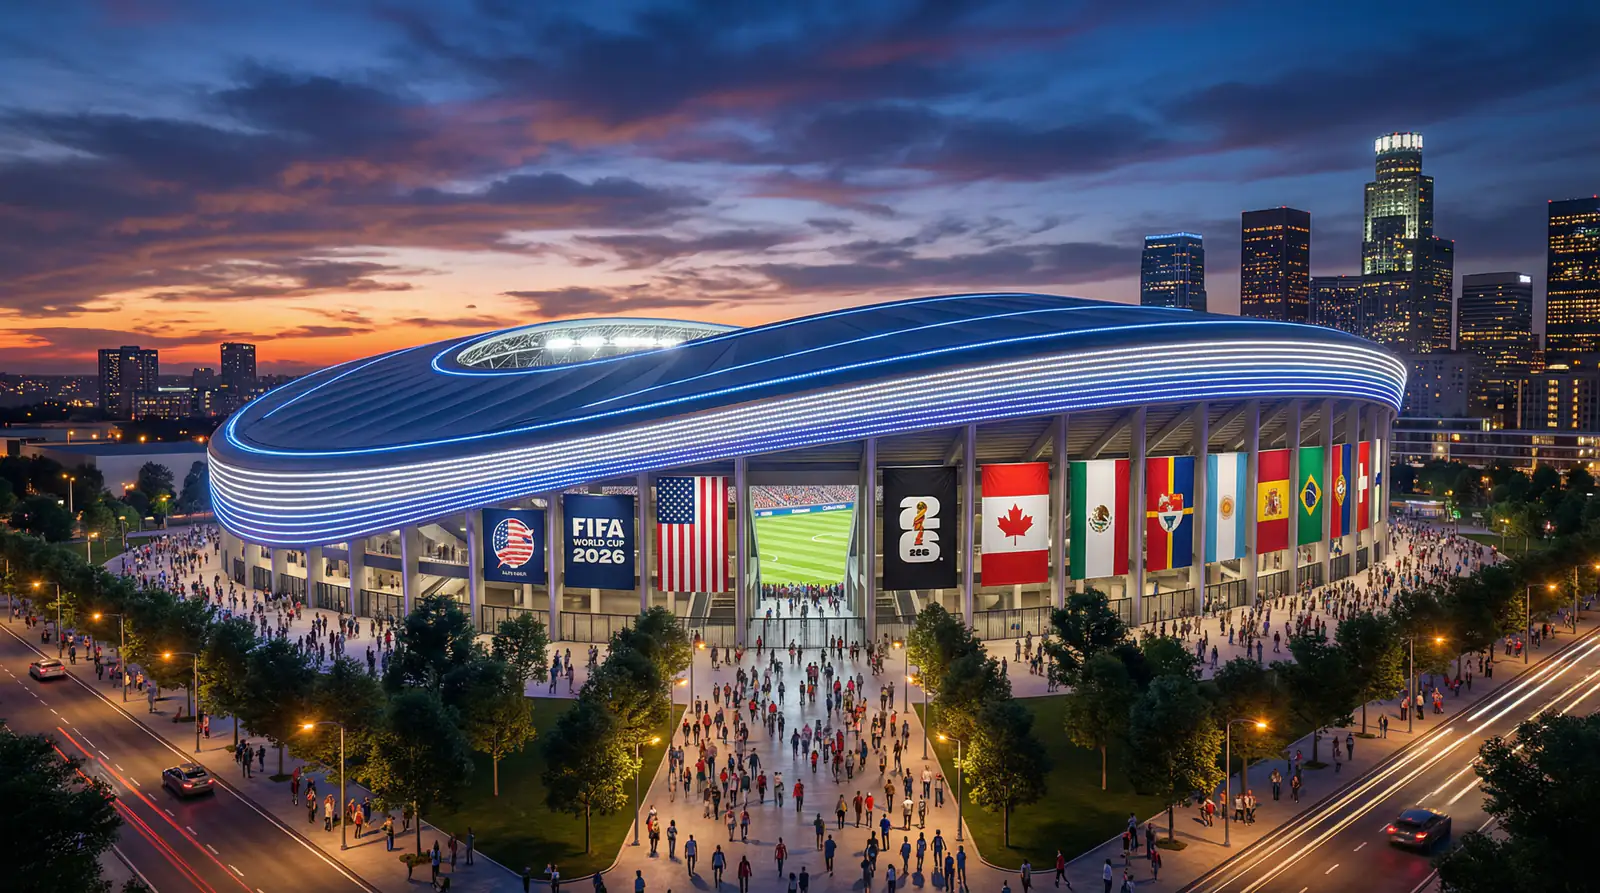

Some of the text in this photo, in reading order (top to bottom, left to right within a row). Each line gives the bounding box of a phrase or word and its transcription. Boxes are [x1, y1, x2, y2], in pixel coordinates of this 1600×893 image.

[573, 517, 625, 538] FIFA
[573, 538, 625, 547] WORLD CUP
[573, 548, 625, 564] 2026
